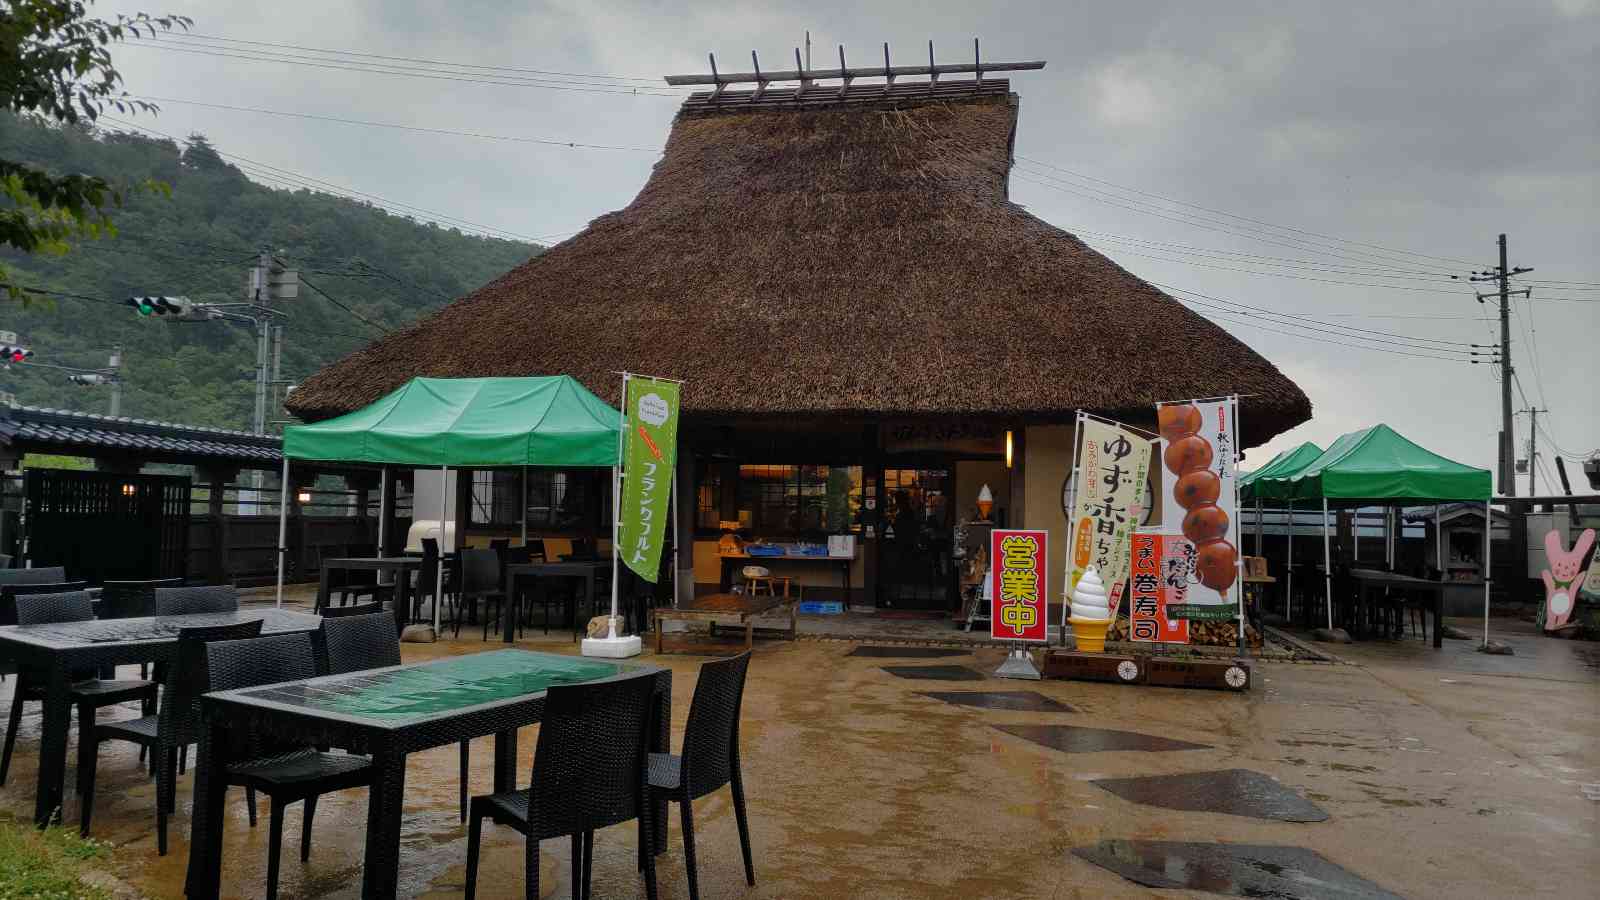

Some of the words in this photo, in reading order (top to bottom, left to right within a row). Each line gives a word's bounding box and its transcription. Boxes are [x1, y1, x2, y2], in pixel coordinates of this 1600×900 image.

[632, 462, 657, 564] フランクフルト
[1092, 434, 1132, 582] ゆず香ちゃ
[1001, 535, 1038, 634] 営業中
[1167, 559, 1189, 600] だんご
